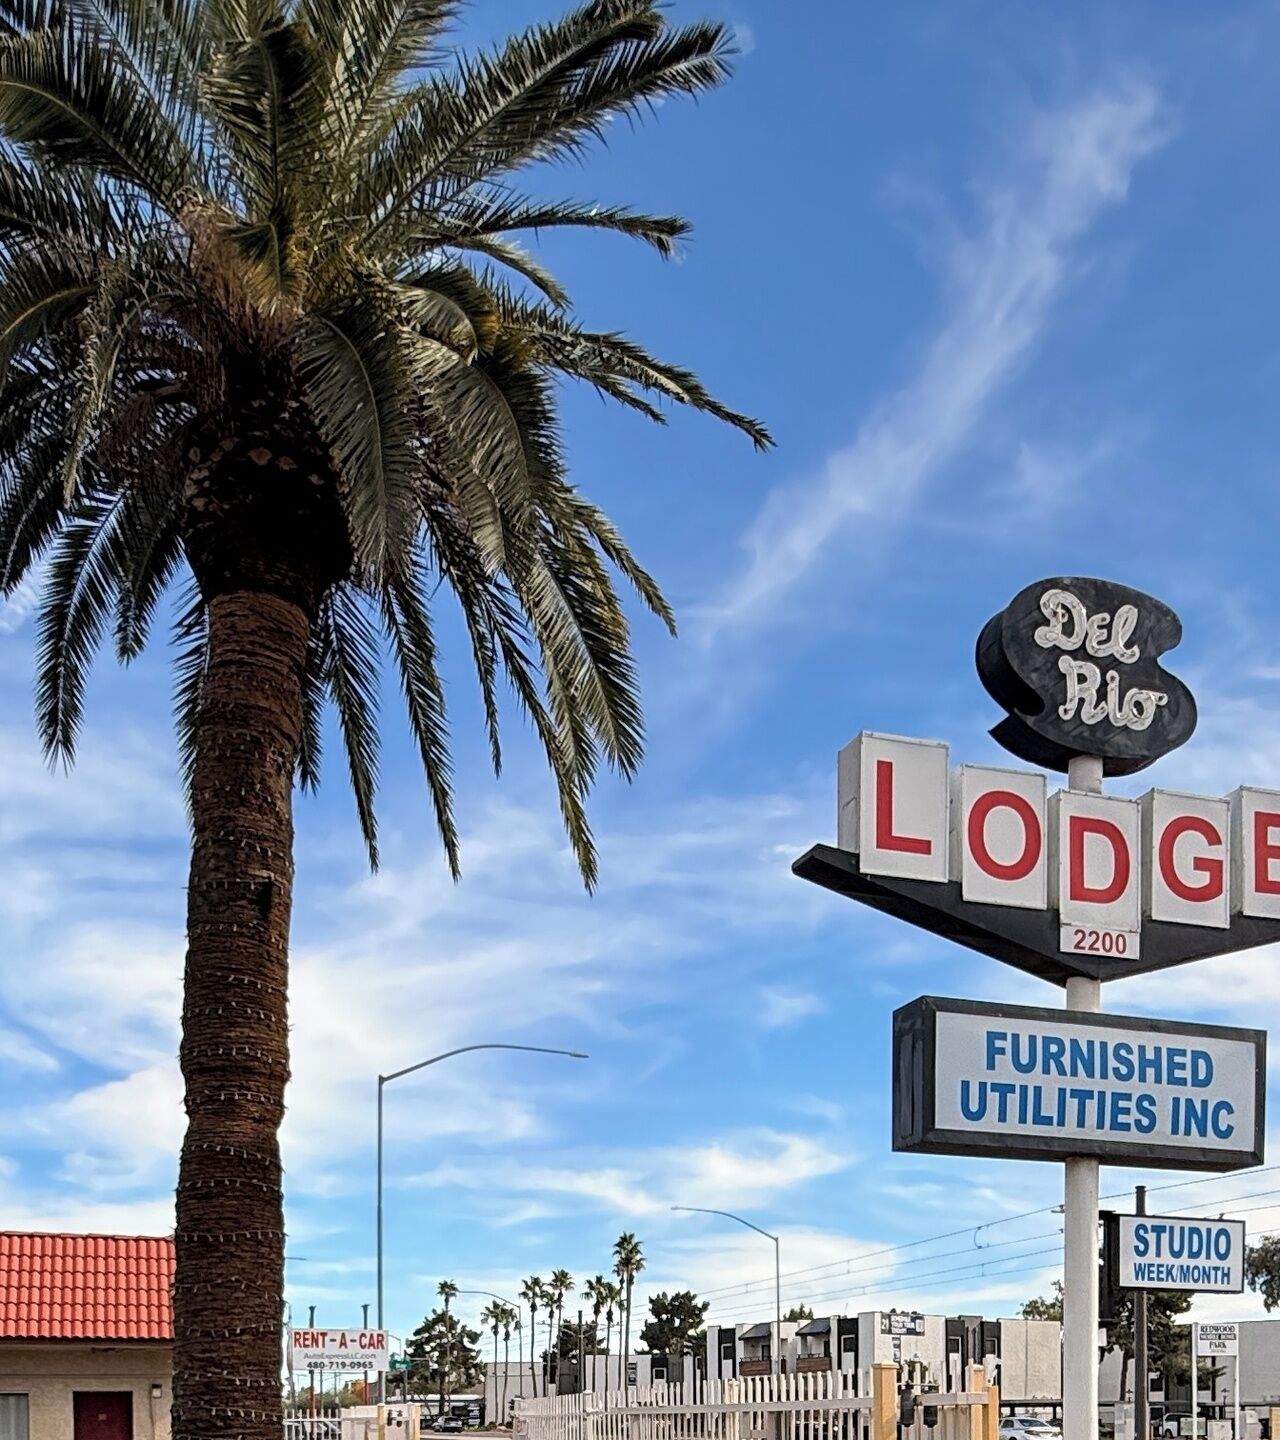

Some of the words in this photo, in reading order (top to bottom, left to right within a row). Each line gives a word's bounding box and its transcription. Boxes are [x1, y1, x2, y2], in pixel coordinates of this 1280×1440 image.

[1034, 589, 1139, 663] Del
[1058, 655, 1167, 730] Rio
[1073, 929, 1127, 955] 2200
[986, 1031, 1214, 1088] FURNISHED
[960, 1080, 1157, 1133] UTILITIES
[1171, 1097, 1235, 1139] INC
[1133, 1223, 1232, 1261] STUDIO
[1133, 1262, 1231, 1285] WEEK/MONTH
[294, 1331, 384, 1350] RENT-A-CAR
